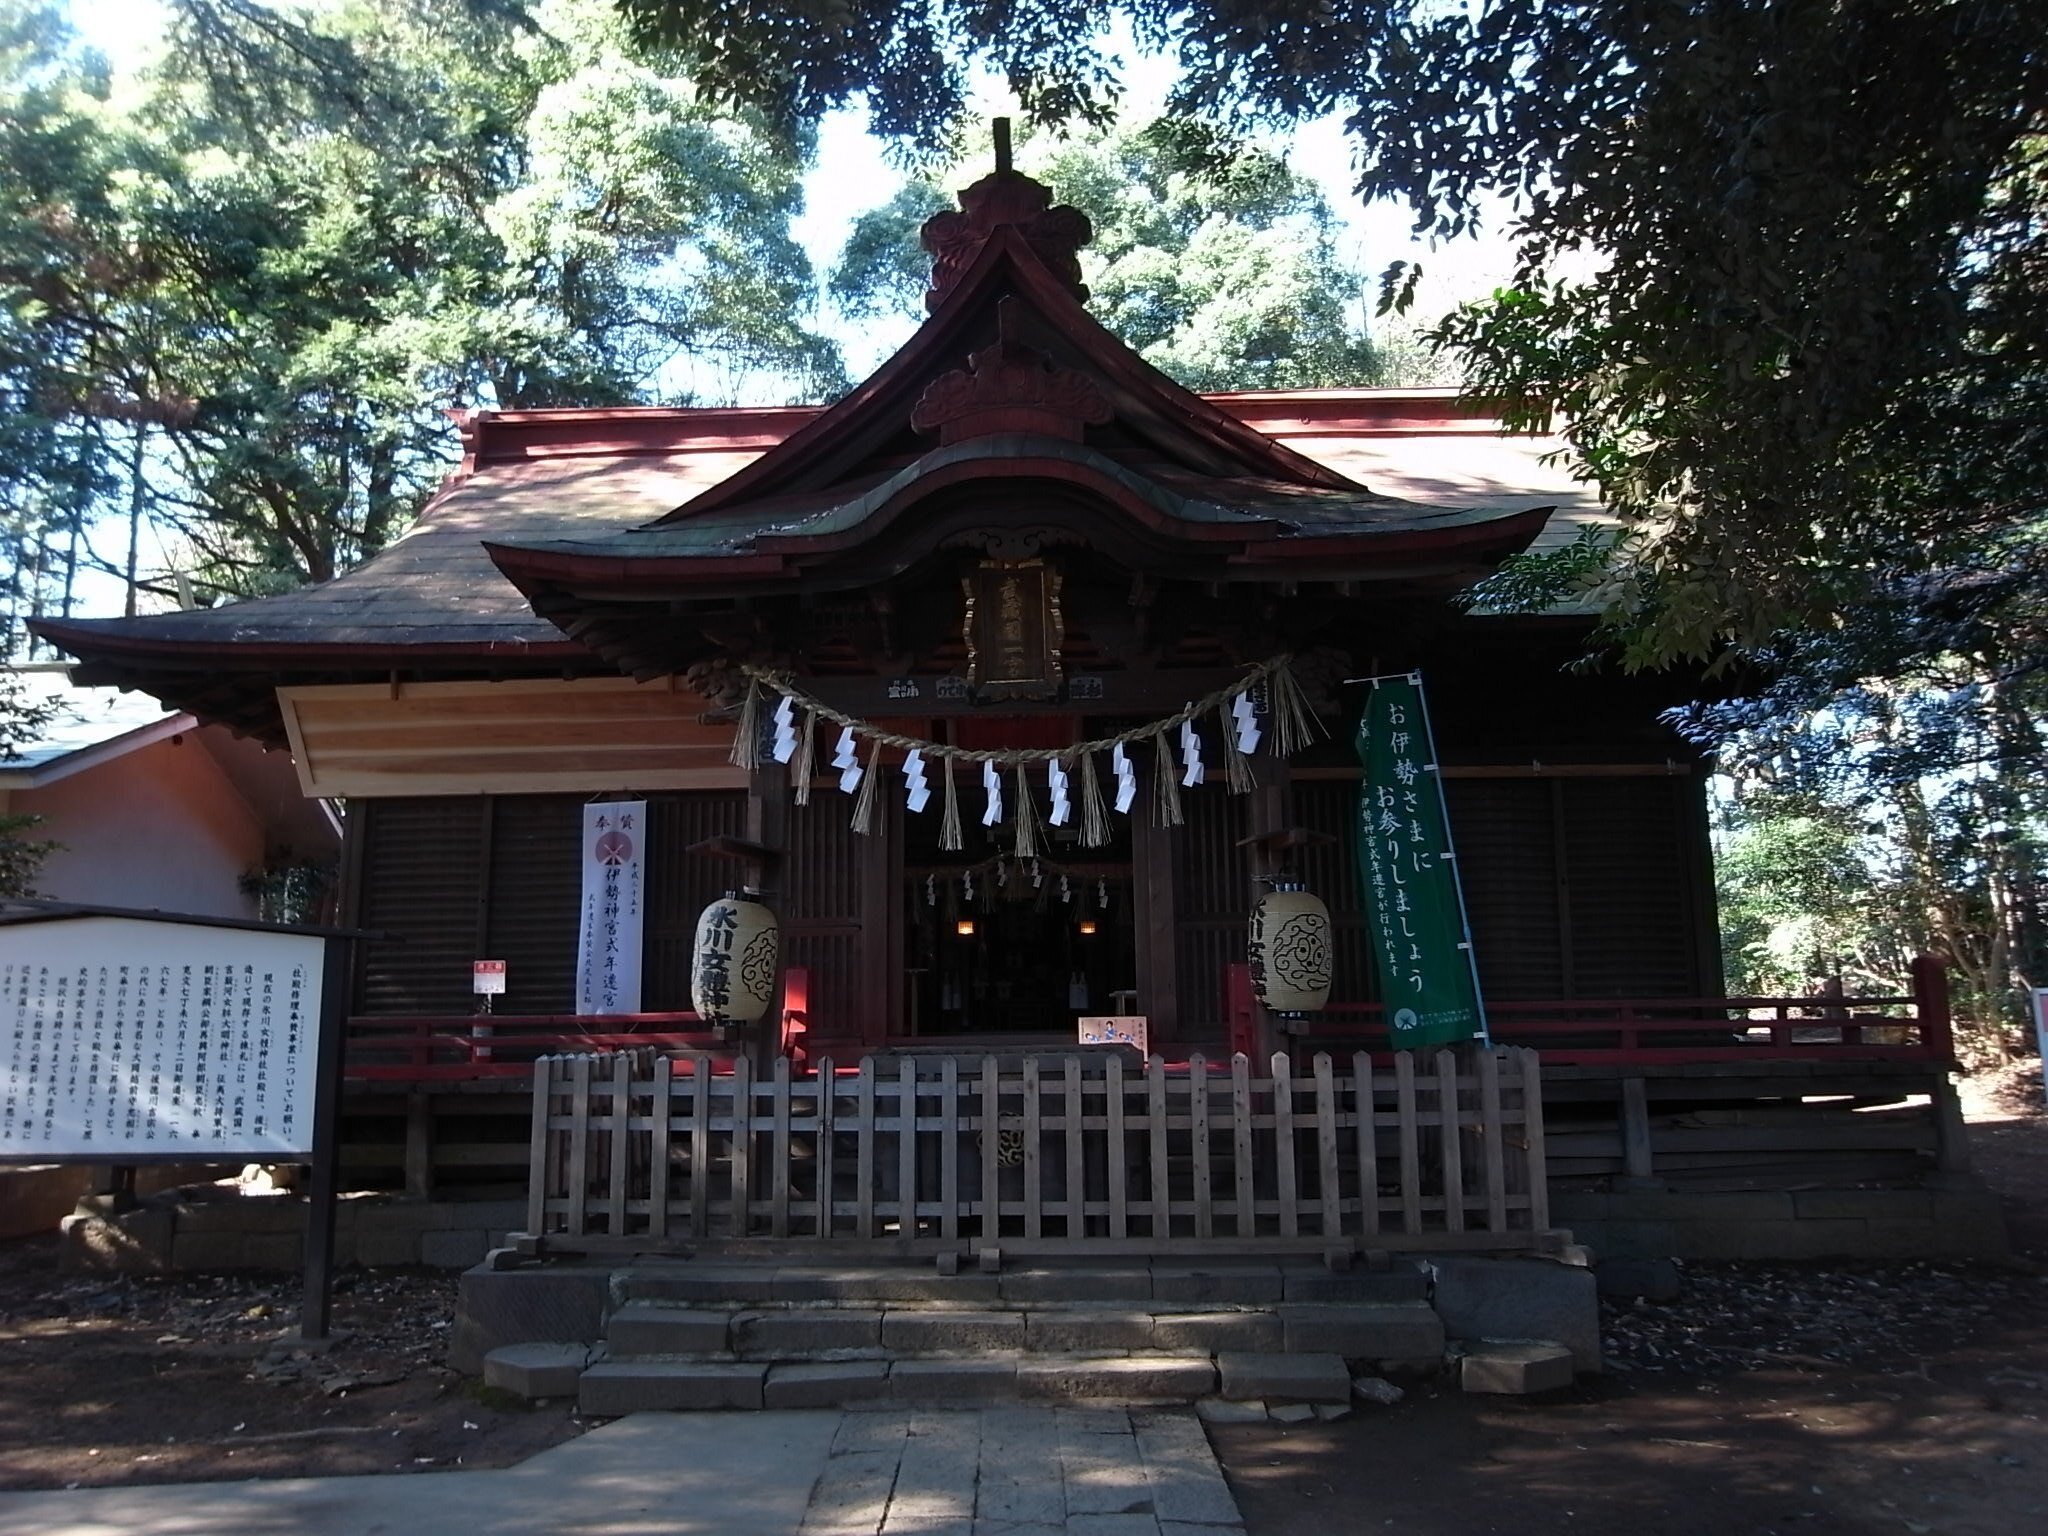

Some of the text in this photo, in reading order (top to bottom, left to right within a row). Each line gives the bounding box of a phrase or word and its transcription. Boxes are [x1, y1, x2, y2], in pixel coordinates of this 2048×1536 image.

[1389, 703, 1432, 872] お伊勢さまに
[602, 868, 622, 1008] 伊勢神宮式年遷宮
[1376, 785, 1424, 992] お参りしましょう
